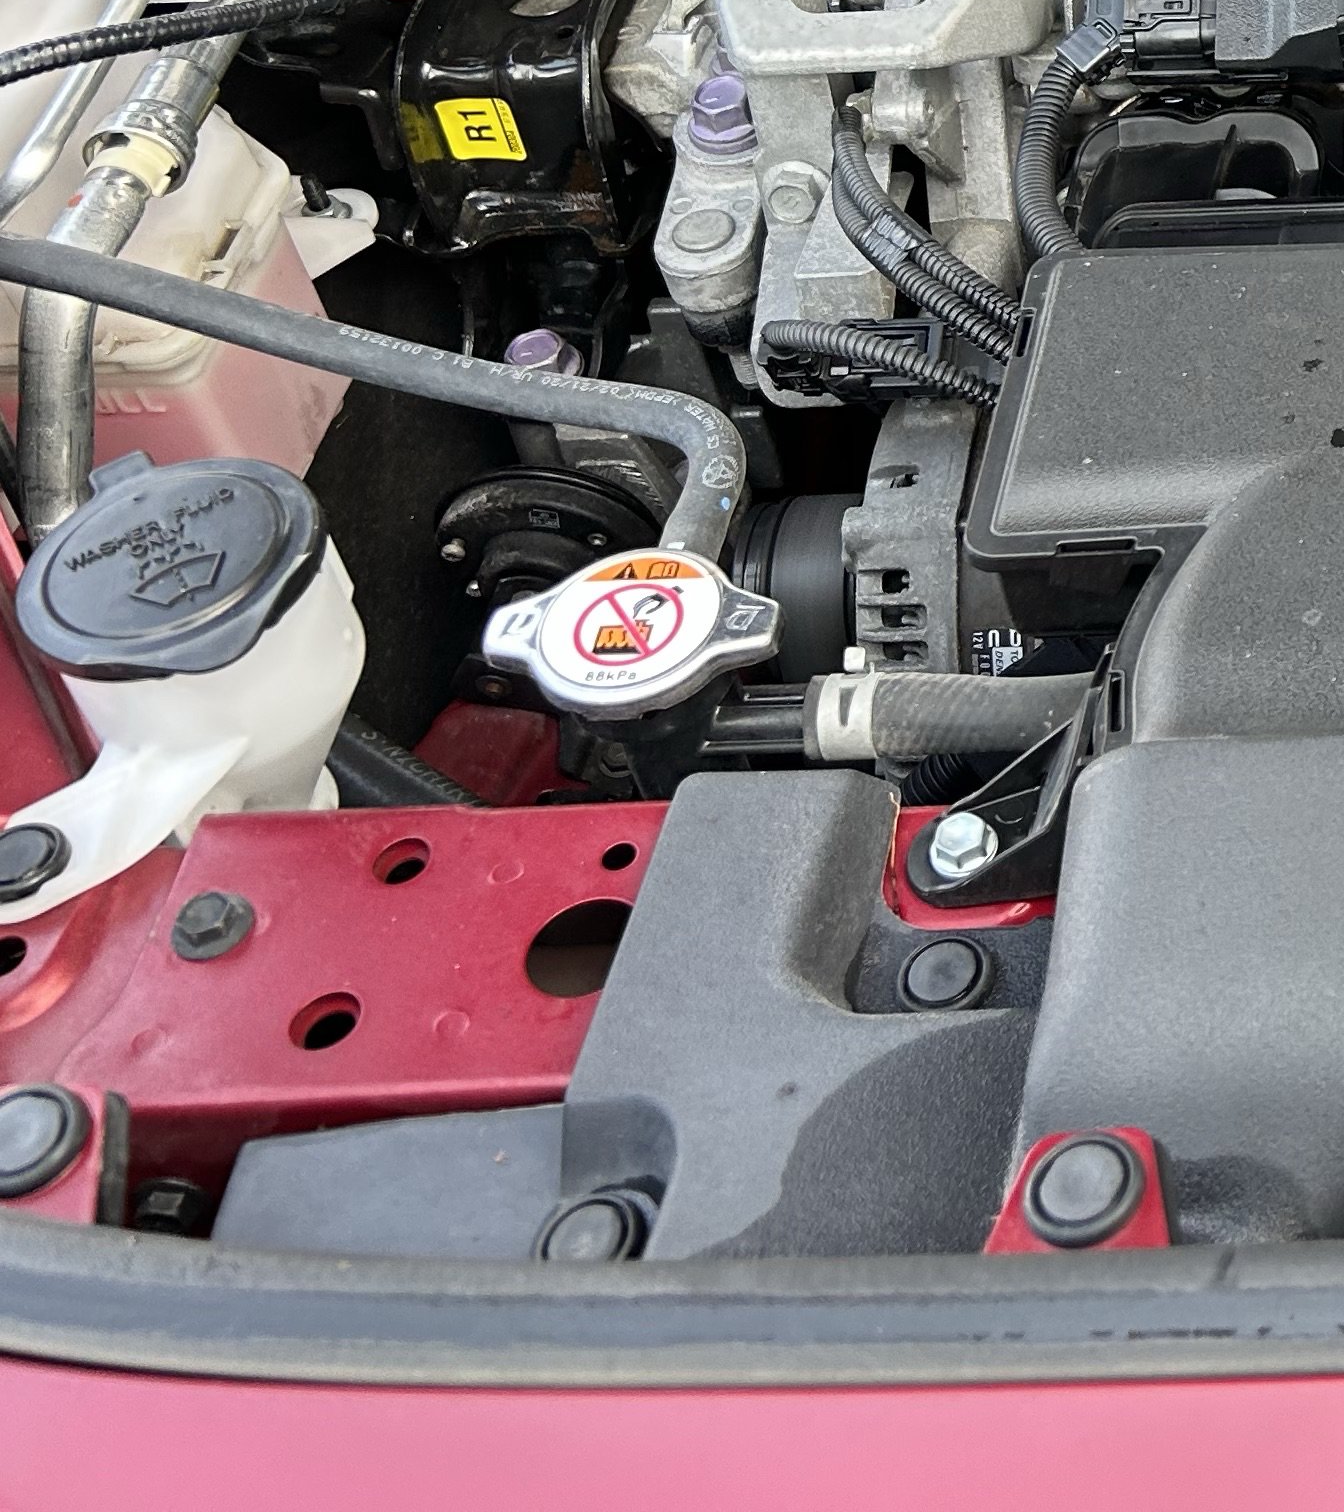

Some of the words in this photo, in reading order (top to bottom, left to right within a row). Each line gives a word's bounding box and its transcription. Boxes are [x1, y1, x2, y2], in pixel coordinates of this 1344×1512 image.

[456, 110, 497, 142] R1
[683, 401, 718, 433] WATER
[64, 520, 162, 572] WASHER
[173, 486, 235, 523] FLUID
[129, 522, 185, 559] ONLY
[584, 670, 638, 683] 88kPa
